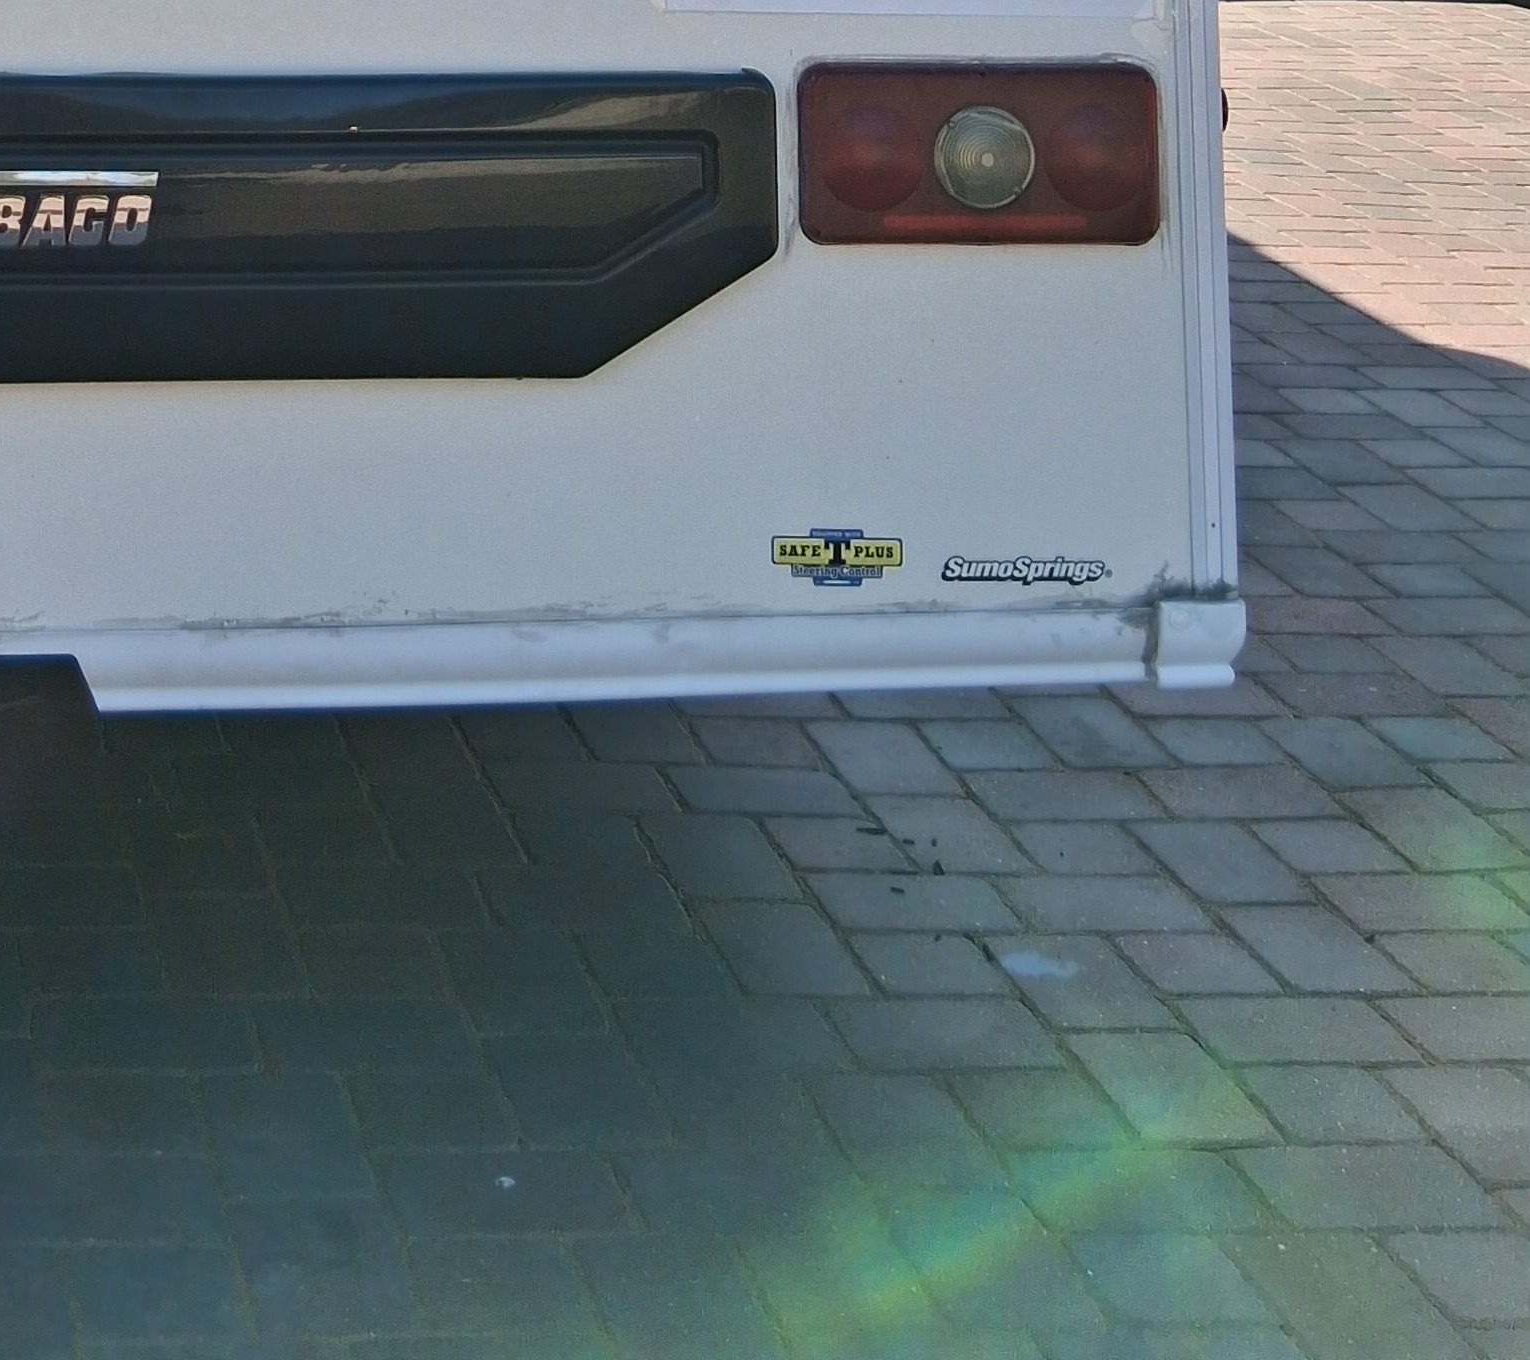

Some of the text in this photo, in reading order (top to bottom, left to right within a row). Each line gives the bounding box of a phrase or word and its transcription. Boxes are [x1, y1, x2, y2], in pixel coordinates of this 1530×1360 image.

[779, 544, 822, 557] SAFE
[853, 545, 895, 559] PLUS
[793, 564, 882, 579] Steering Control
[941, 555, 1106, 586] SumoSprings
